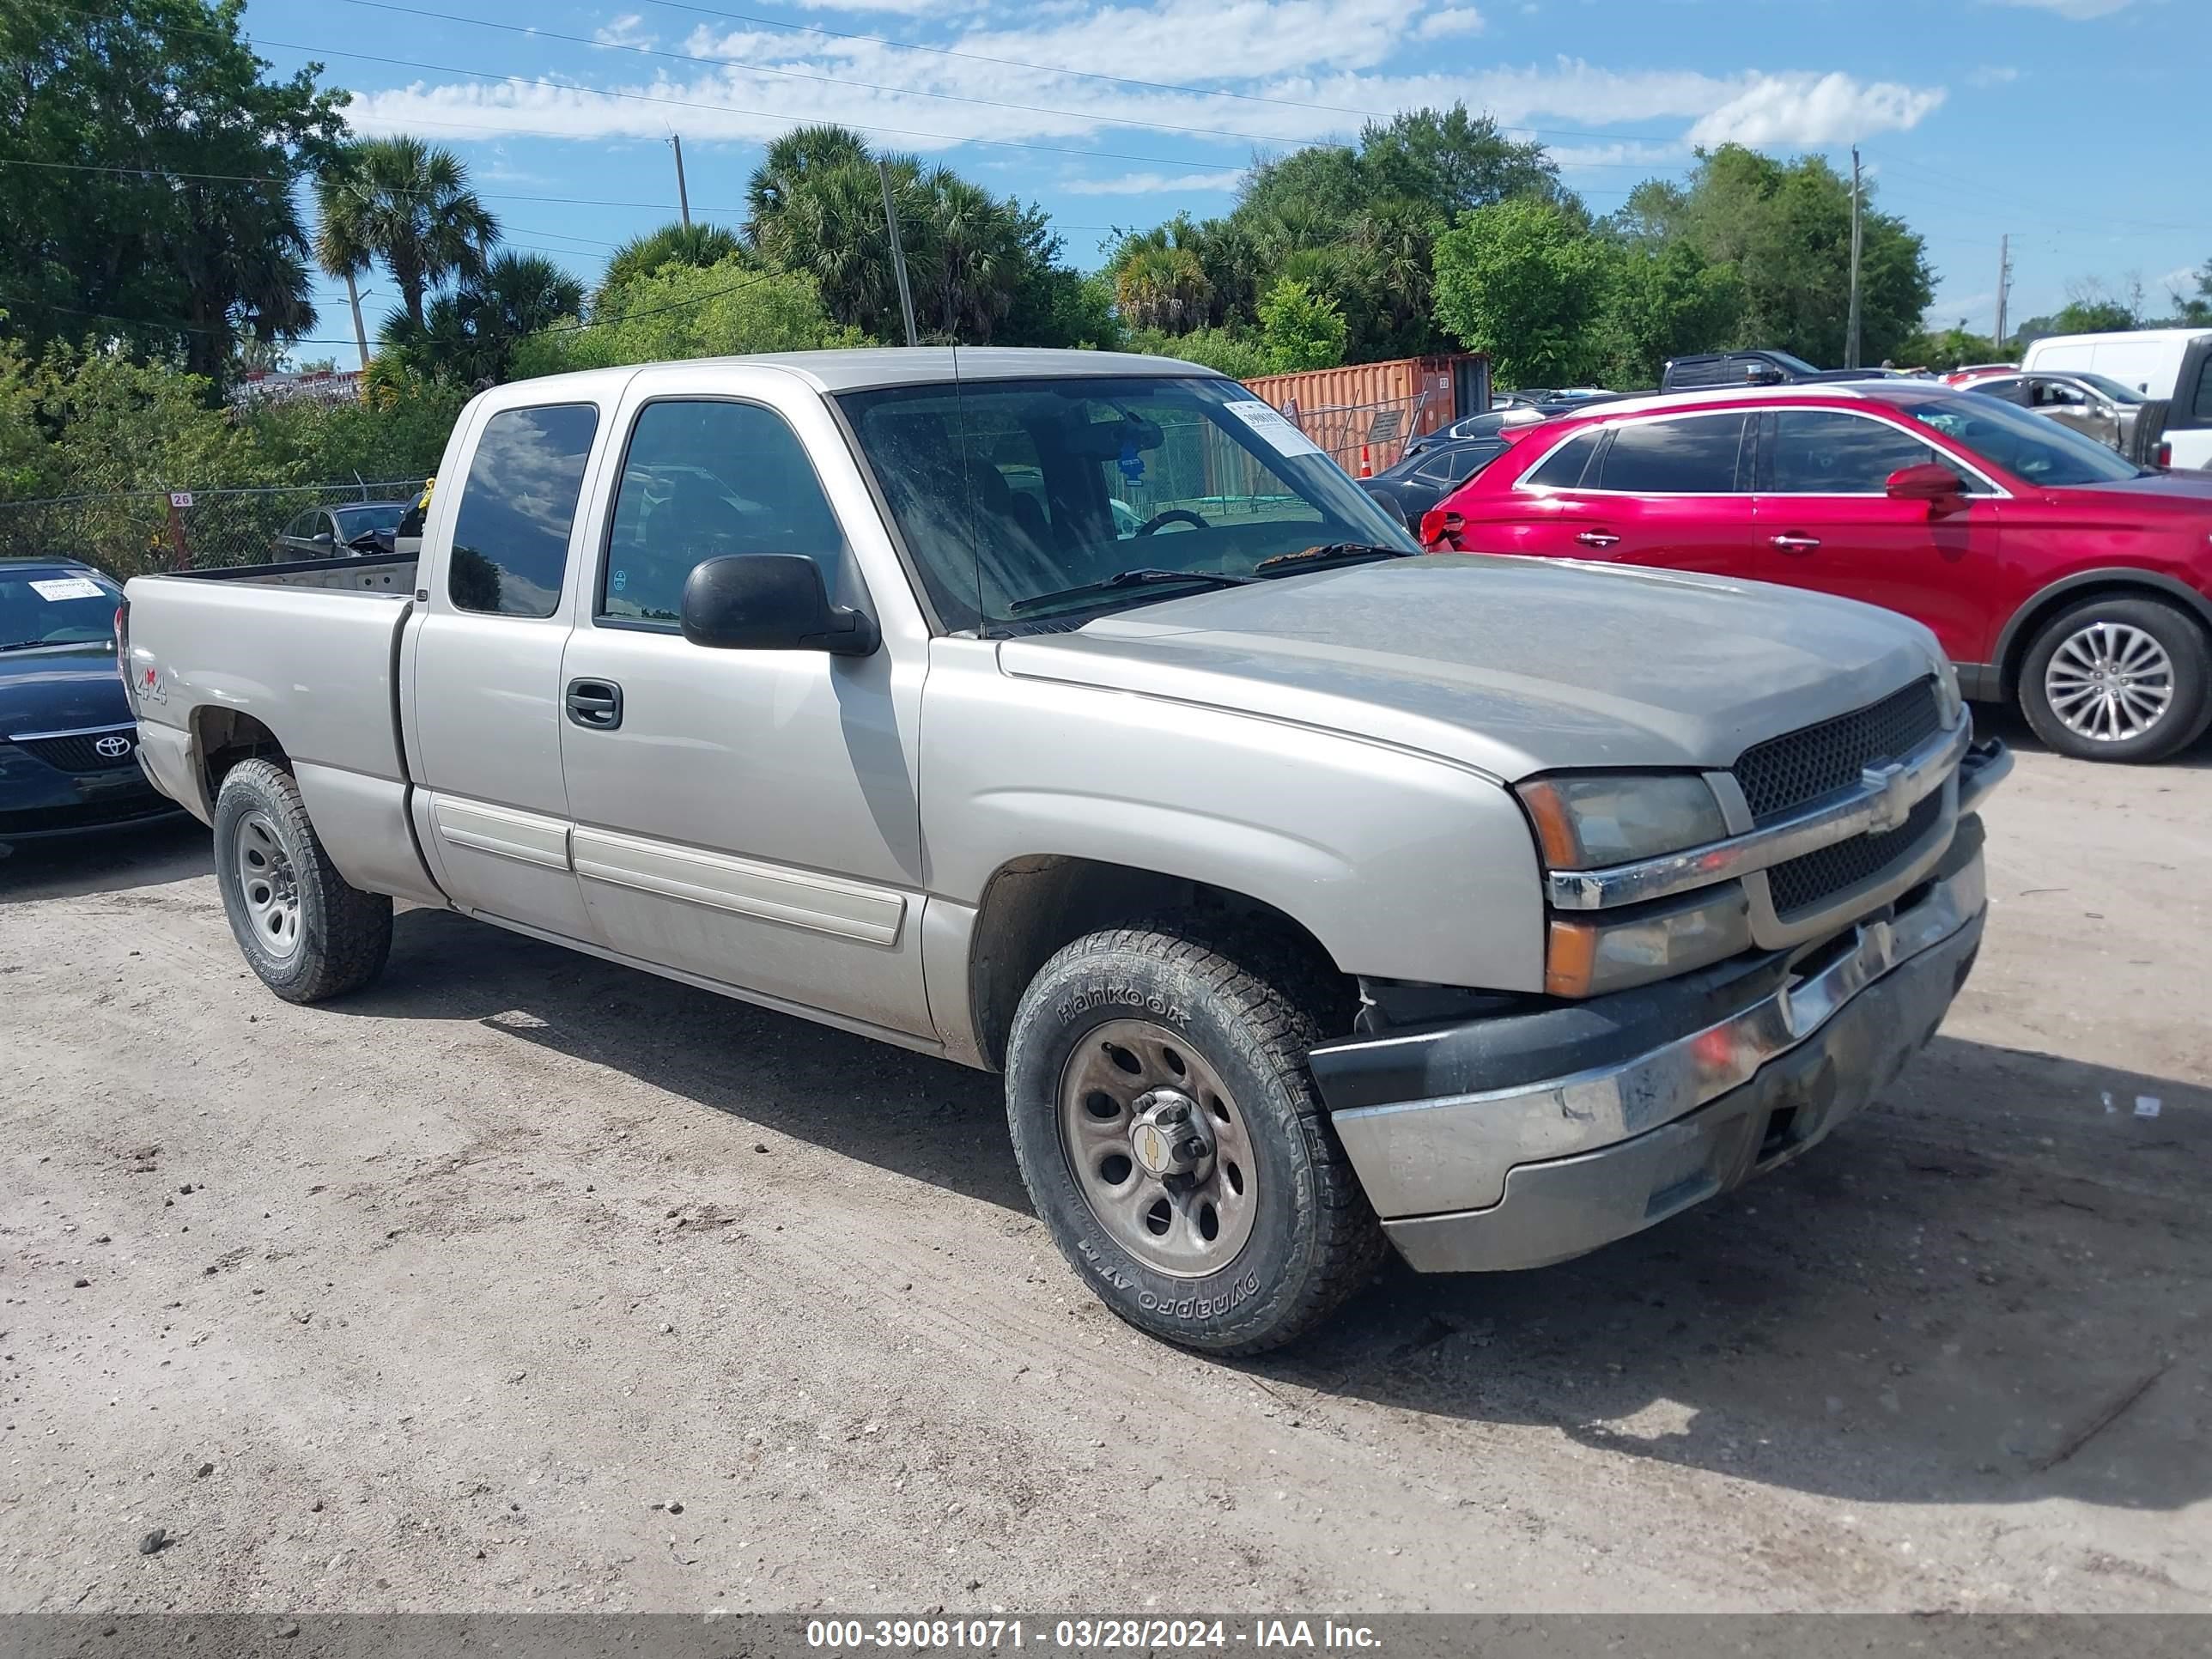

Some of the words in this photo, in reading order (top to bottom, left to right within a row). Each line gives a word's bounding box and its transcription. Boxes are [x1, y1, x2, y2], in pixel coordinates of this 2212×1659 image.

[173, 495, 190, 505] 26
[1055, 986, 1193, 1031] Hankook
[1138, 1266, 1261, 1319] Dynapro
